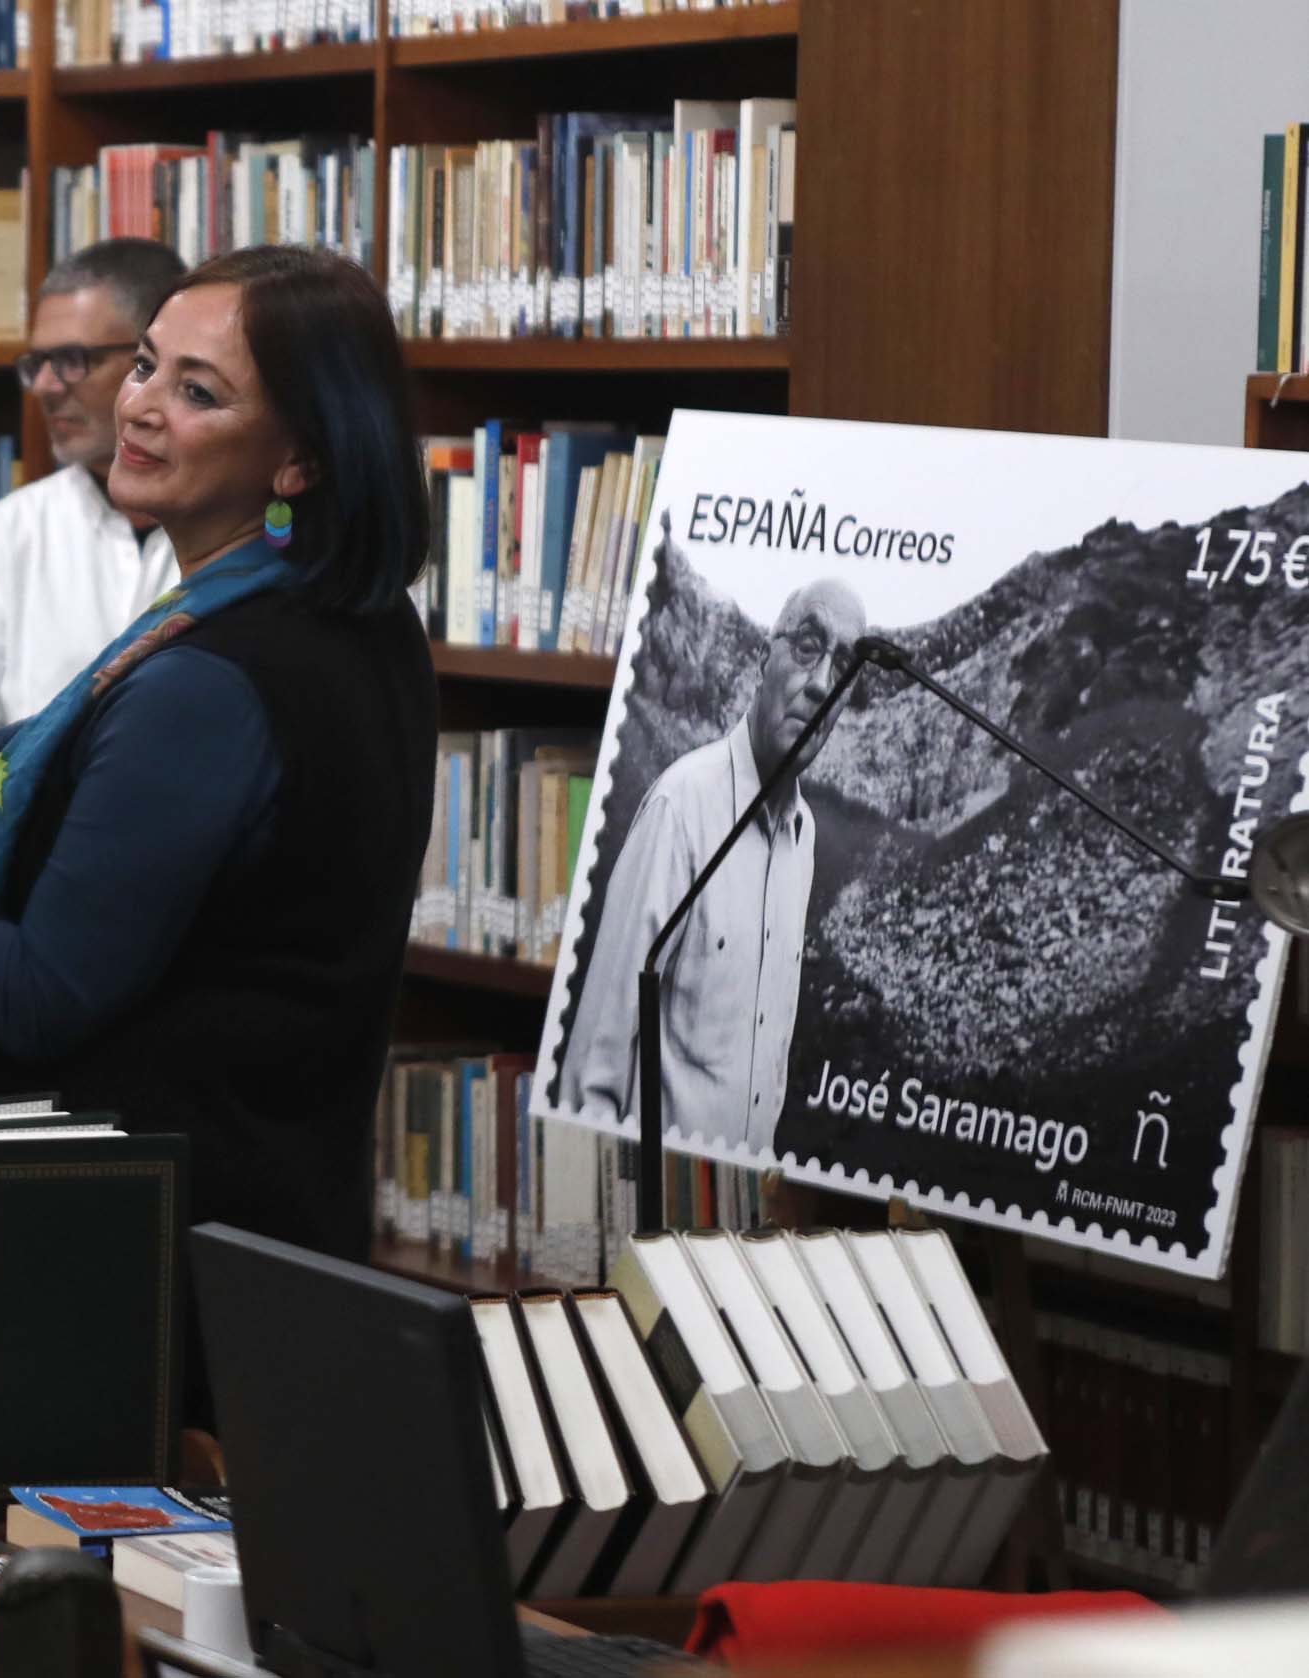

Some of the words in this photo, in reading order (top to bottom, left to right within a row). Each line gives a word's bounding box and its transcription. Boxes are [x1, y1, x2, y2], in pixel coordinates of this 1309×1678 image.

[688, 488, 827, 554] ESPAÑA
[833, 514, 955, 565] Correos
[1186, 527, 1277, 591] 1,75
[1281, 534, 1309, 590] €
[806, 1059, 889, 1122] José
[896, 1078, 1089, 1172] Saramago
[1133, 1091, 1172, 1169] ñ
[1071, 1187, 1144, 1219] RCM-FNMT
[1145, 1206, 1178, 1228] 2023
